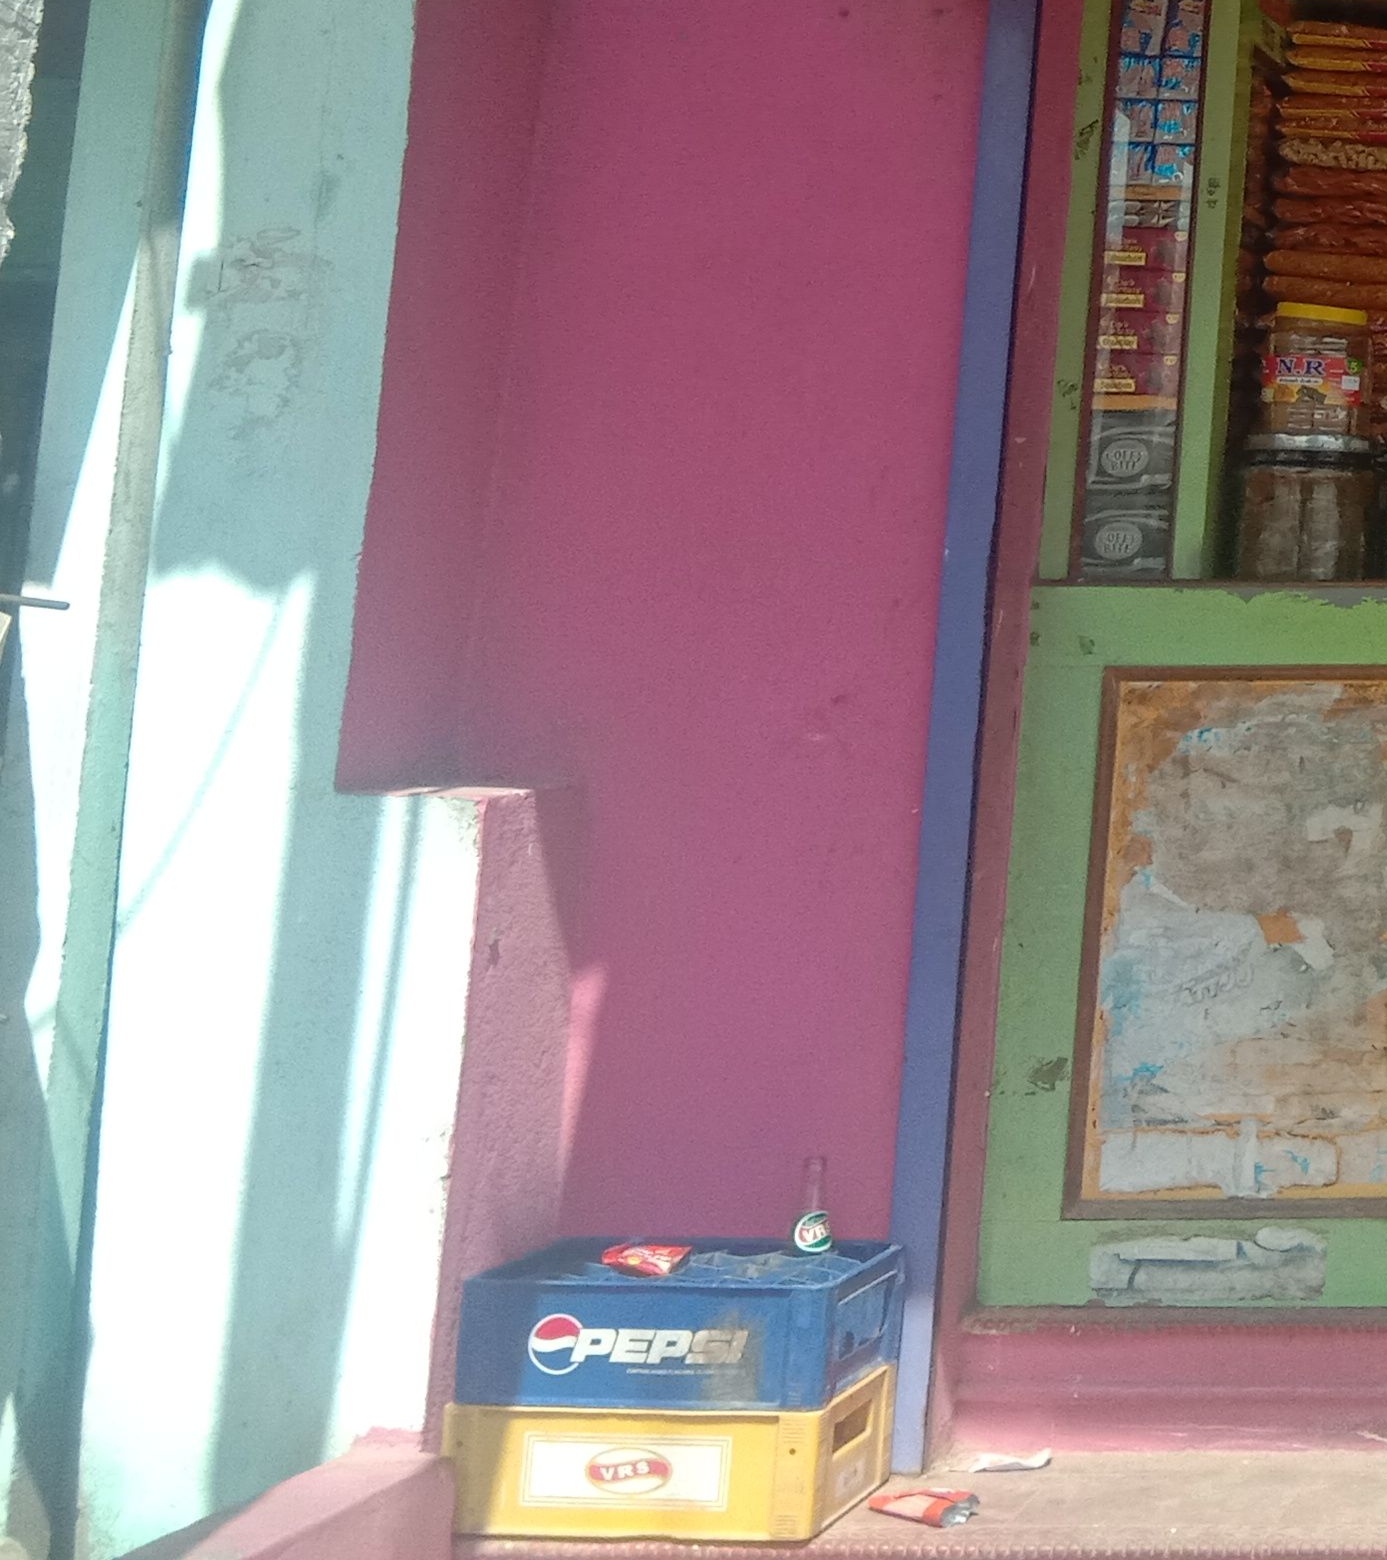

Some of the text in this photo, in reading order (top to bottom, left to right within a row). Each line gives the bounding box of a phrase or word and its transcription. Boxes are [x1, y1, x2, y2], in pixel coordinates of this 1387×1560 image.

[1277, 358, 1326, 376] N.R
[570, 1327, 750, 1365] PEPSI
[600, 1460, 651, 1481] VRS
